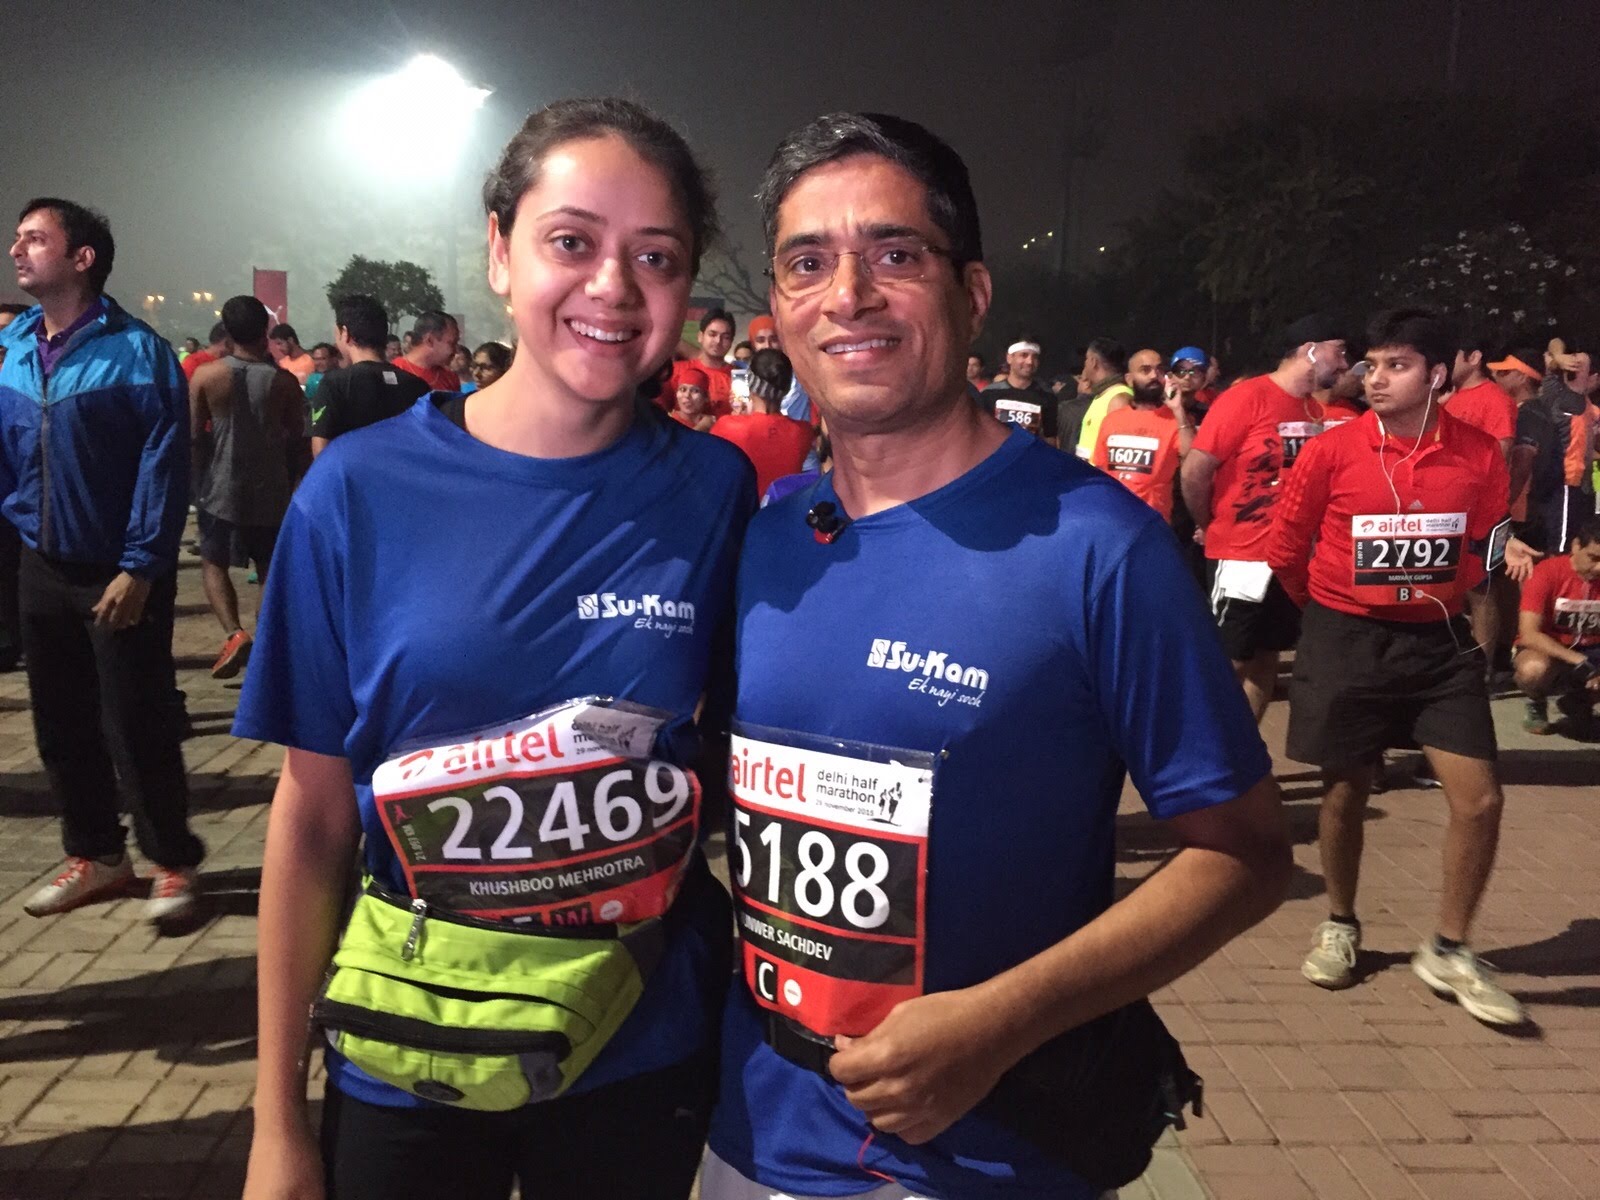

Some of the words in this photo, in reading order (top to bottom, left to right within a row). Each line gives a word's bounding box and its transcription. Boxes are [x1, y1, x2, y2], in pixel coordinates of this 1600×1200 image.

[1007, 410, 1032, 425] 586
[1109, 448, 1151, 465] 16071
[1378, 518, 1422, 533] airtel
[1371, 538, 1450, 568] 2792
[1400, 588, 1409, 600] B
[443, 722, 564, 775] airtel
[732, 748, 806, 803] airtel
[817, 769, 848, 786] delhi
[852, 774, 879, 791] half
[816, 783, 876, 804] marathon
[427, 760, 690, 860] 22469
[469, 876, 554, 896] KHUSHBOO
[558, 855, 646, 889] MEHROTRA
[734, 807, 890, 929] 5188
[776, 929, 833, 961] SACHDEV
[758, 961, 774, 1001] C
